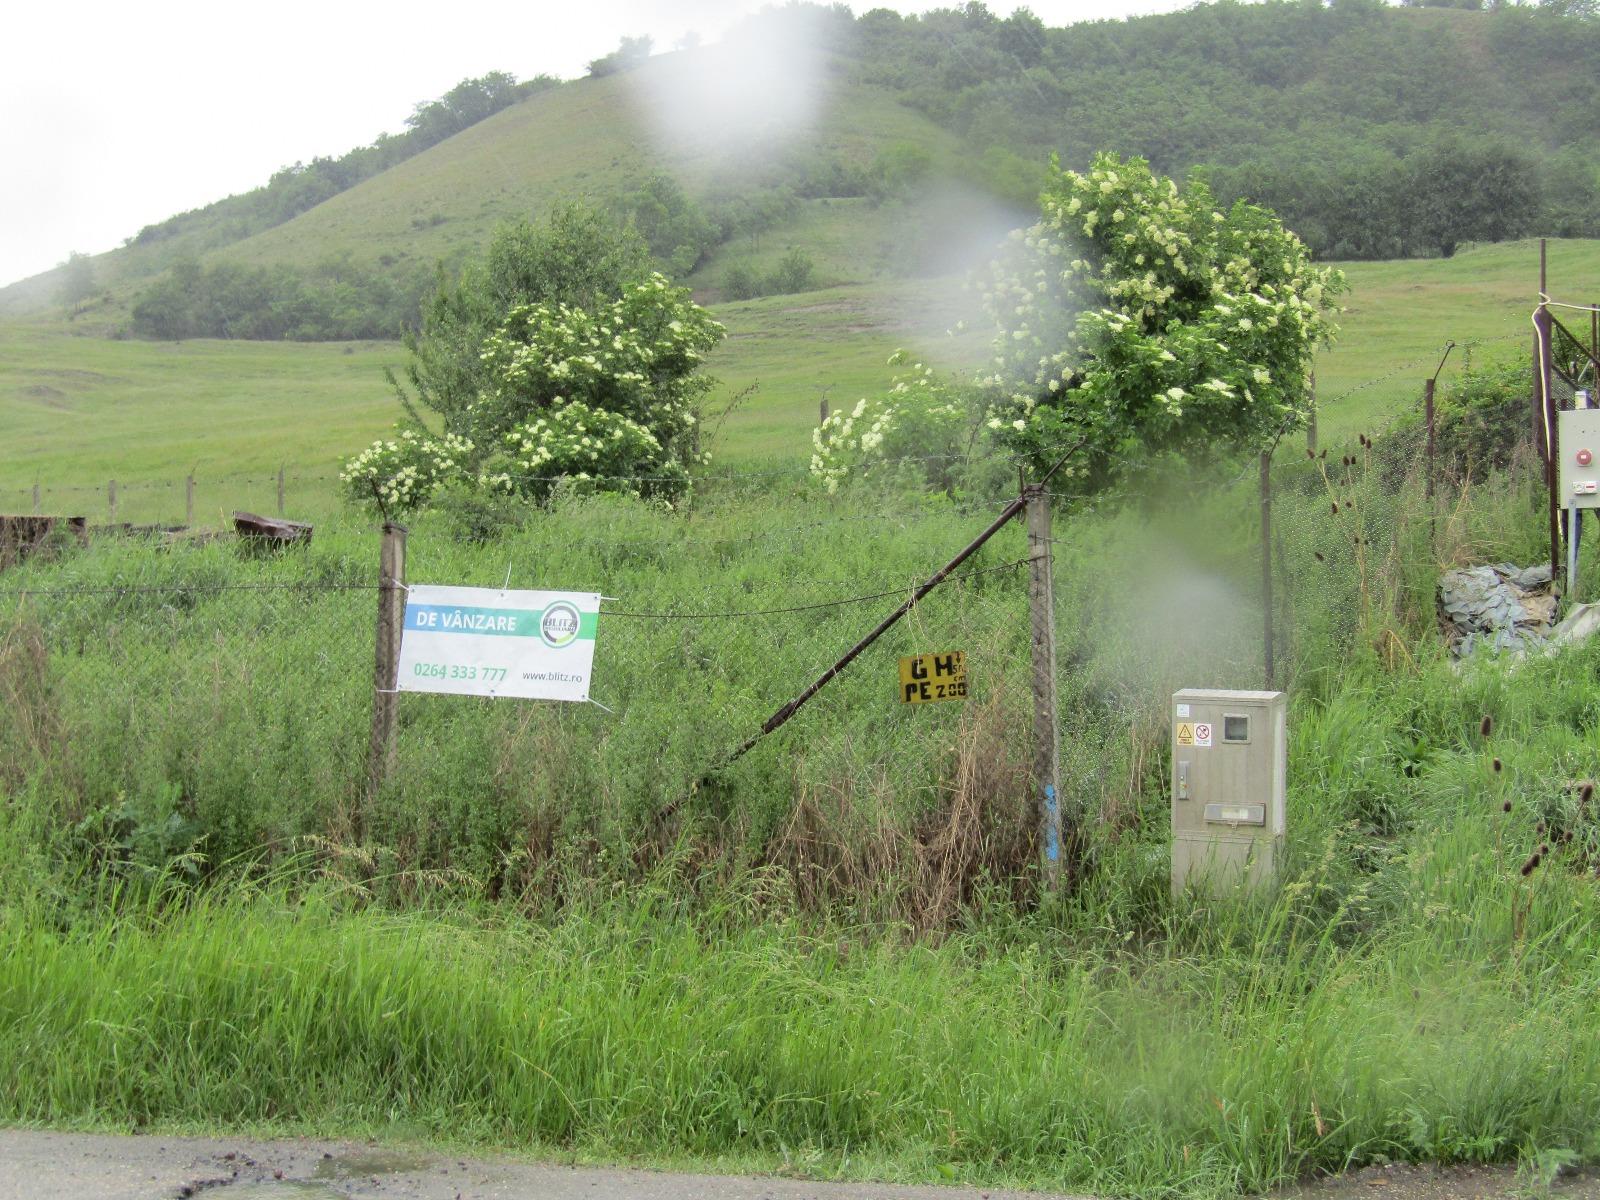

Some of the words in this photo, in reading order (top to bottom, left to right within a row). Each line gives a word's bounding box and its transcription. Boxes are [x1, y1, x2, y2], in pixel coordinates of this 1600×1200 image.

[416, 611, 437, 627] DE
[442, 610, 517, 631] VÂNZARE
[414, 663, 447, 680] 0264
[450, 666, 477, 680] 333
[482, 667, 507, 682] 777
[522, 670, 583, 683] www.blitz.ro
[905, 681, 932, 702] PE
